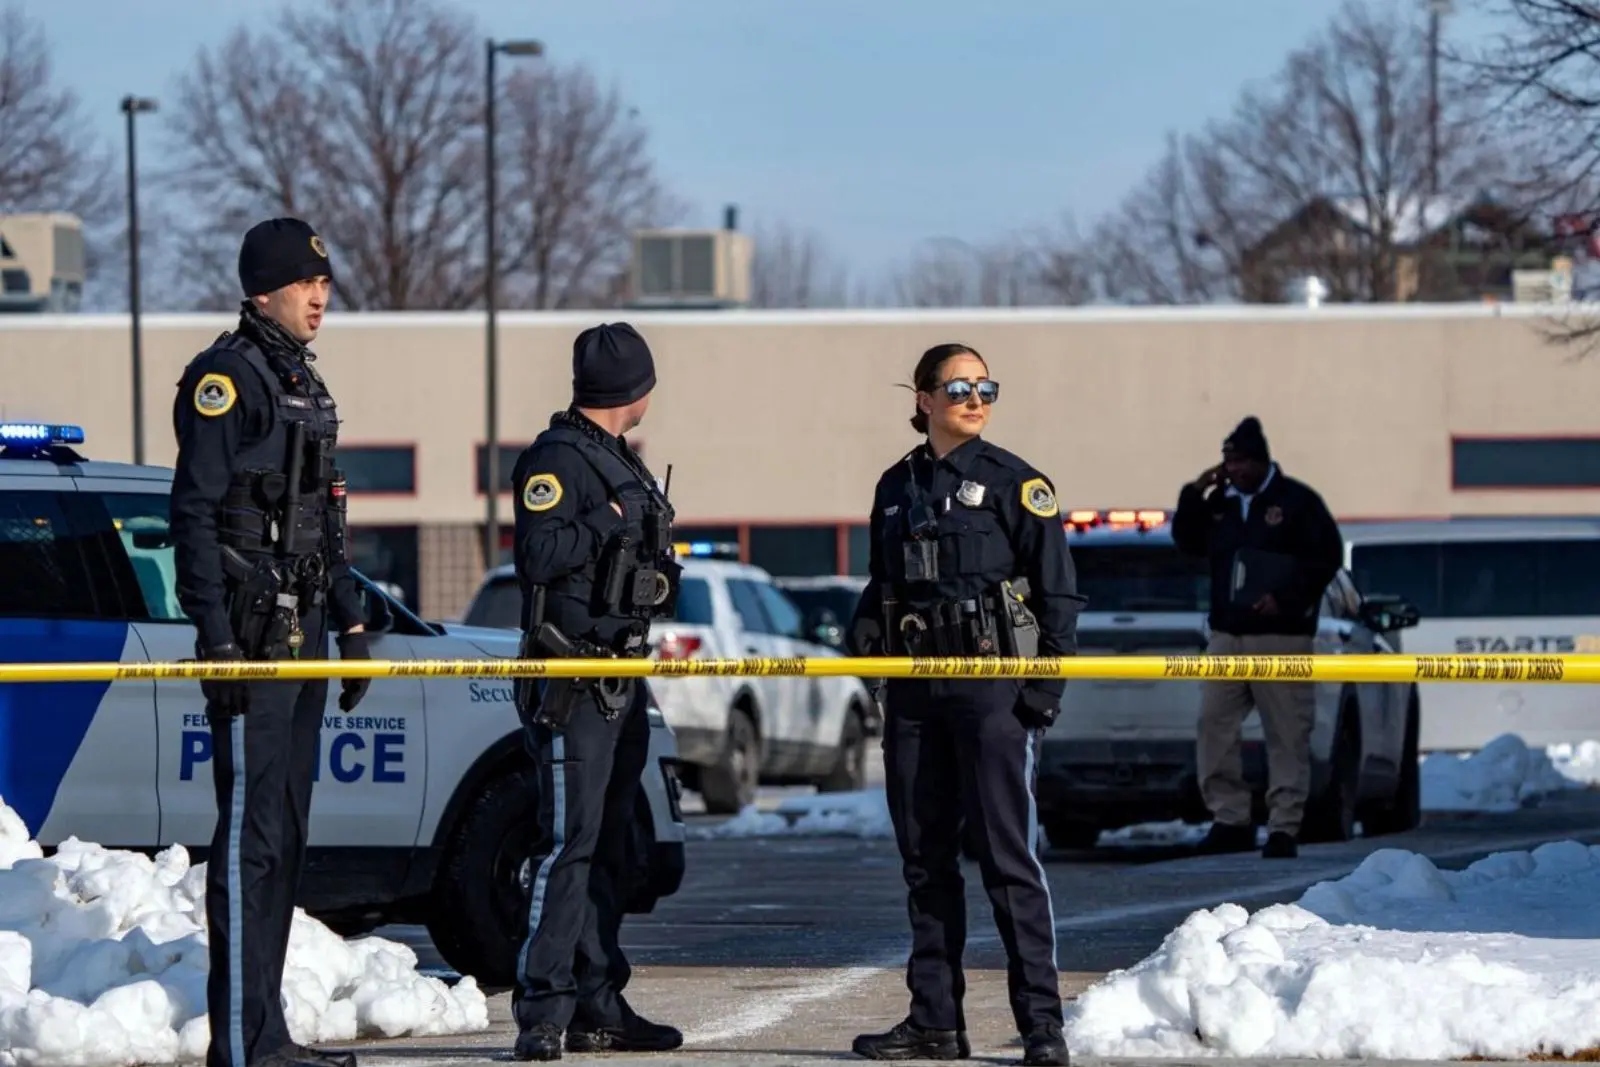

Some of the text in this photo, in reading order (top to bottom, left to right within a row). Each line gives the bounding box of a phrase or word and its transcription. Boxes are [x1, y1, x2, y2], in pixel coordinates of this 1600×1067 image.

[1455, 635, 1575, 653] STARTS
[911, 657, 1062, 676] POLICE LINE DO NOT CROSS
[1164, 656, 1314, 678] POLICE LINE DO NOT CROSS
[1415, 657, 1564, 680] POLICE LINE DO NOT CROSS
[469, 682, 513, 702] Secu
[346, 717, 405, 730] SERVICE
[180, 730, 405, 783] PCE
